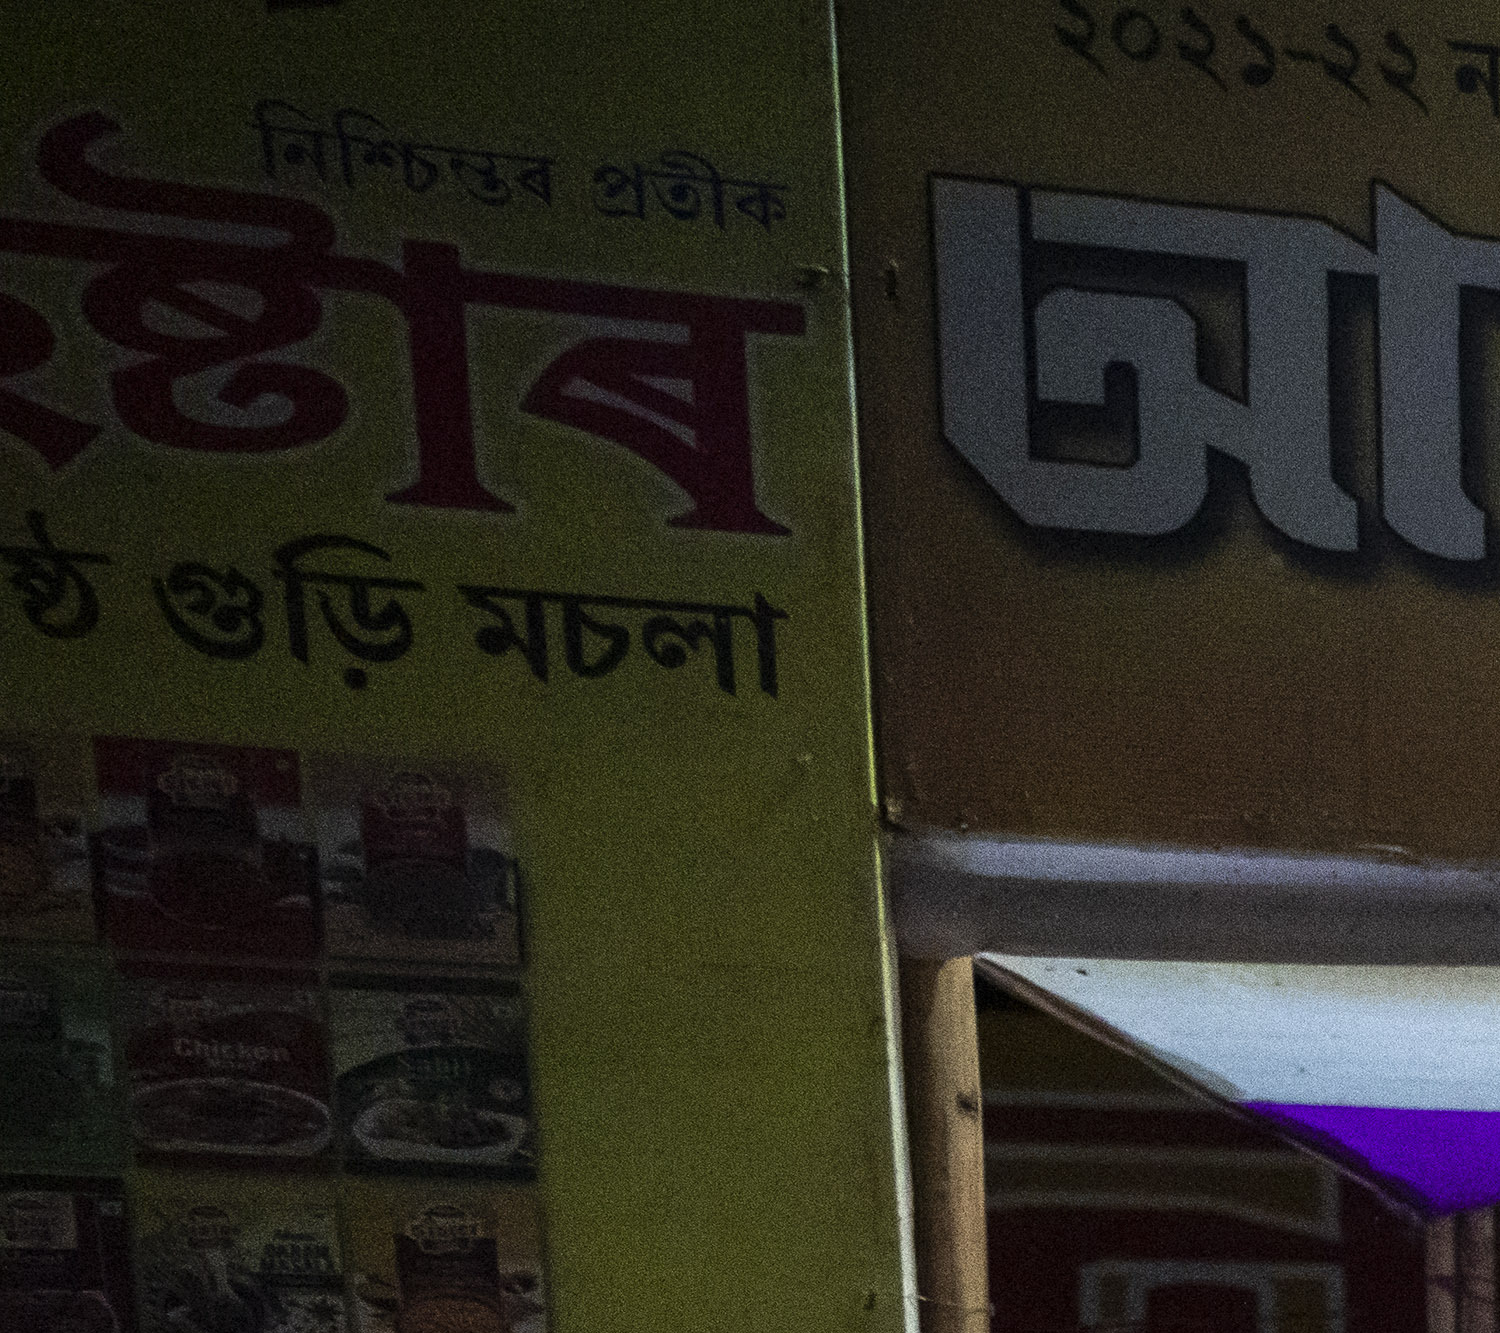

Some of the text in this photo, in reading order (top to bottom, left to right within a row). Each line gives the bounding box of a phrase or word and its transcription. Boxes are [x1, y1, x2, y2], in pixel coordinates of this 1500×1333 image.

[1052, 0, 1430, 115] ২০২১-২২
[0, 110, 808, 538] ষ্টাৰ
[457, 581, 788, 699] মচলা
